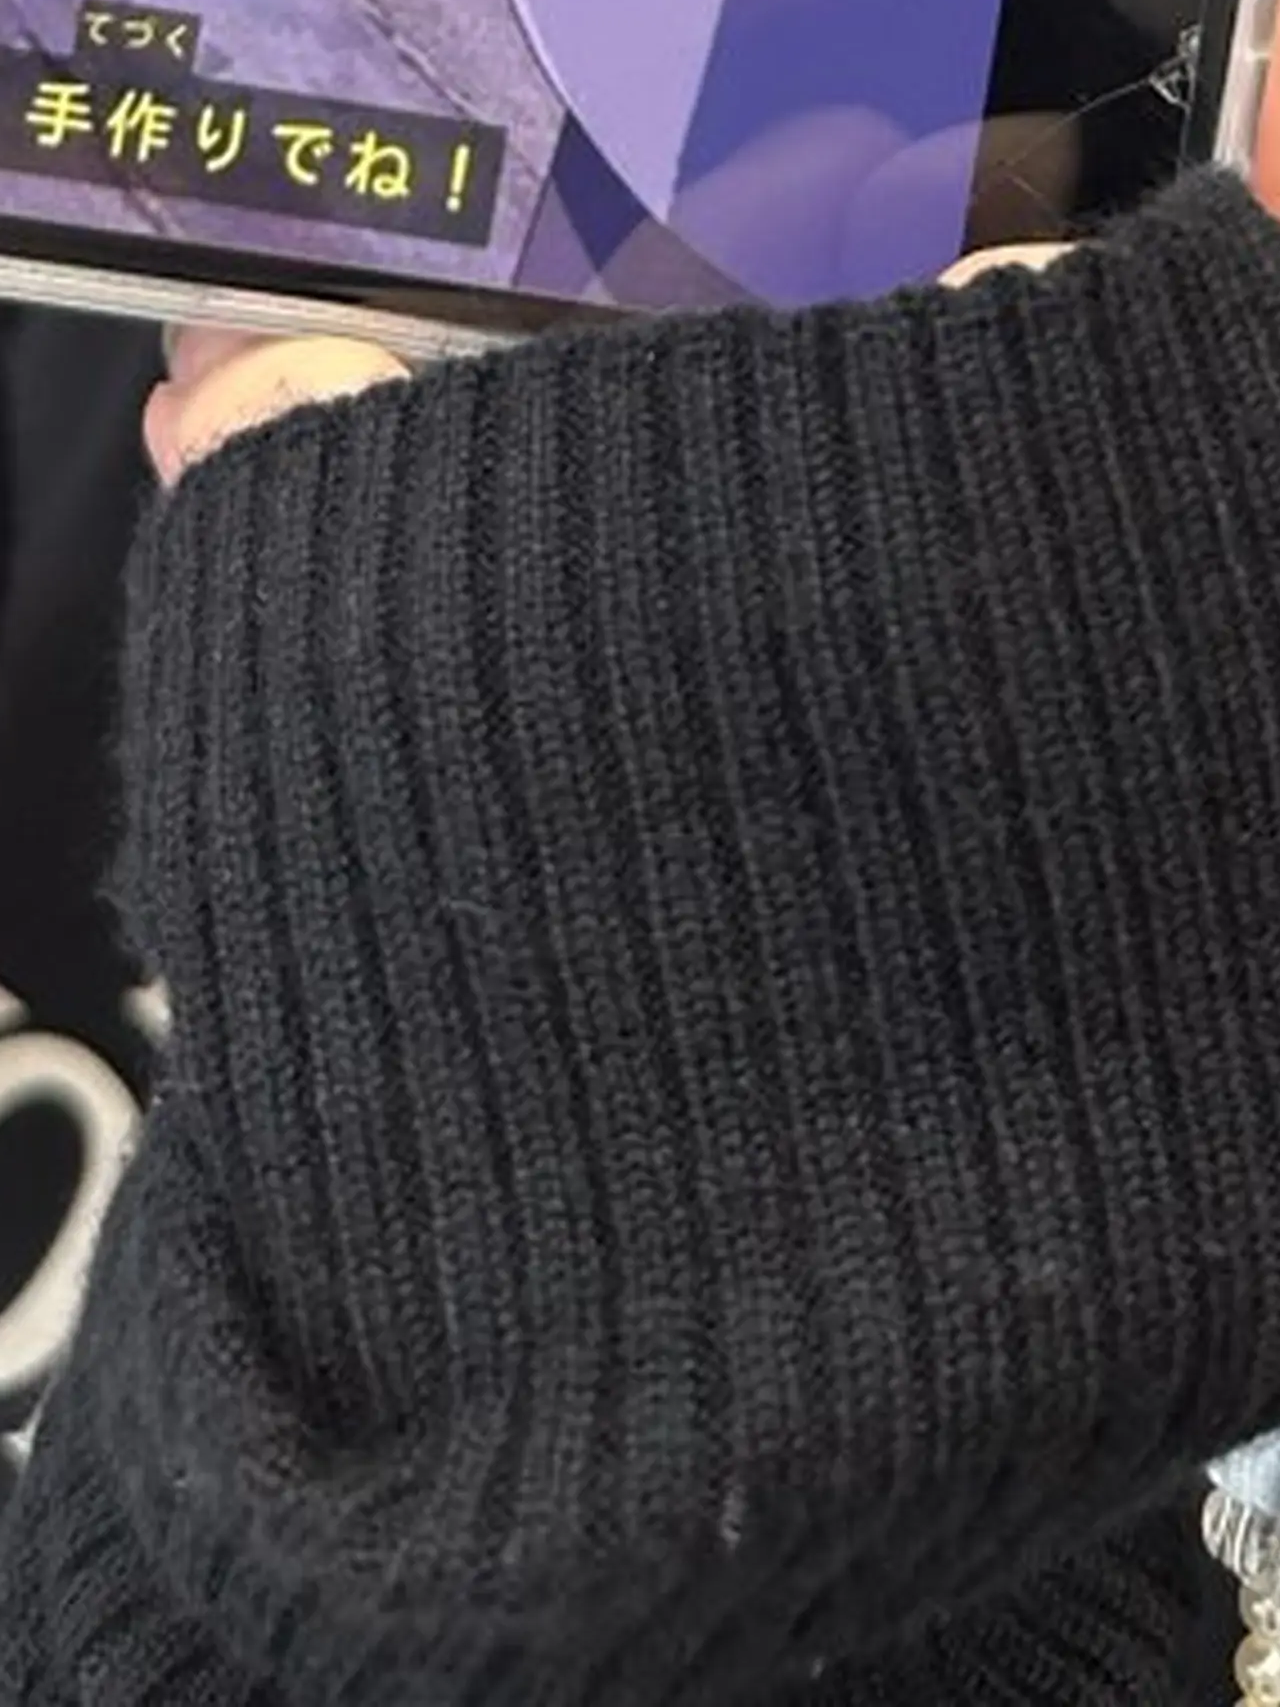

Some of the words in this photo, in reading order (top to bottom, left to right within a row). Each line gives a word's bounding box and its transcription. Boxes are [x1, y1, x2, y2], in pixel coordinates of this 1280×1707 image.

[83, 10, 189, 60] てづく
[24, 82, 471, 213] 手作りでね！
